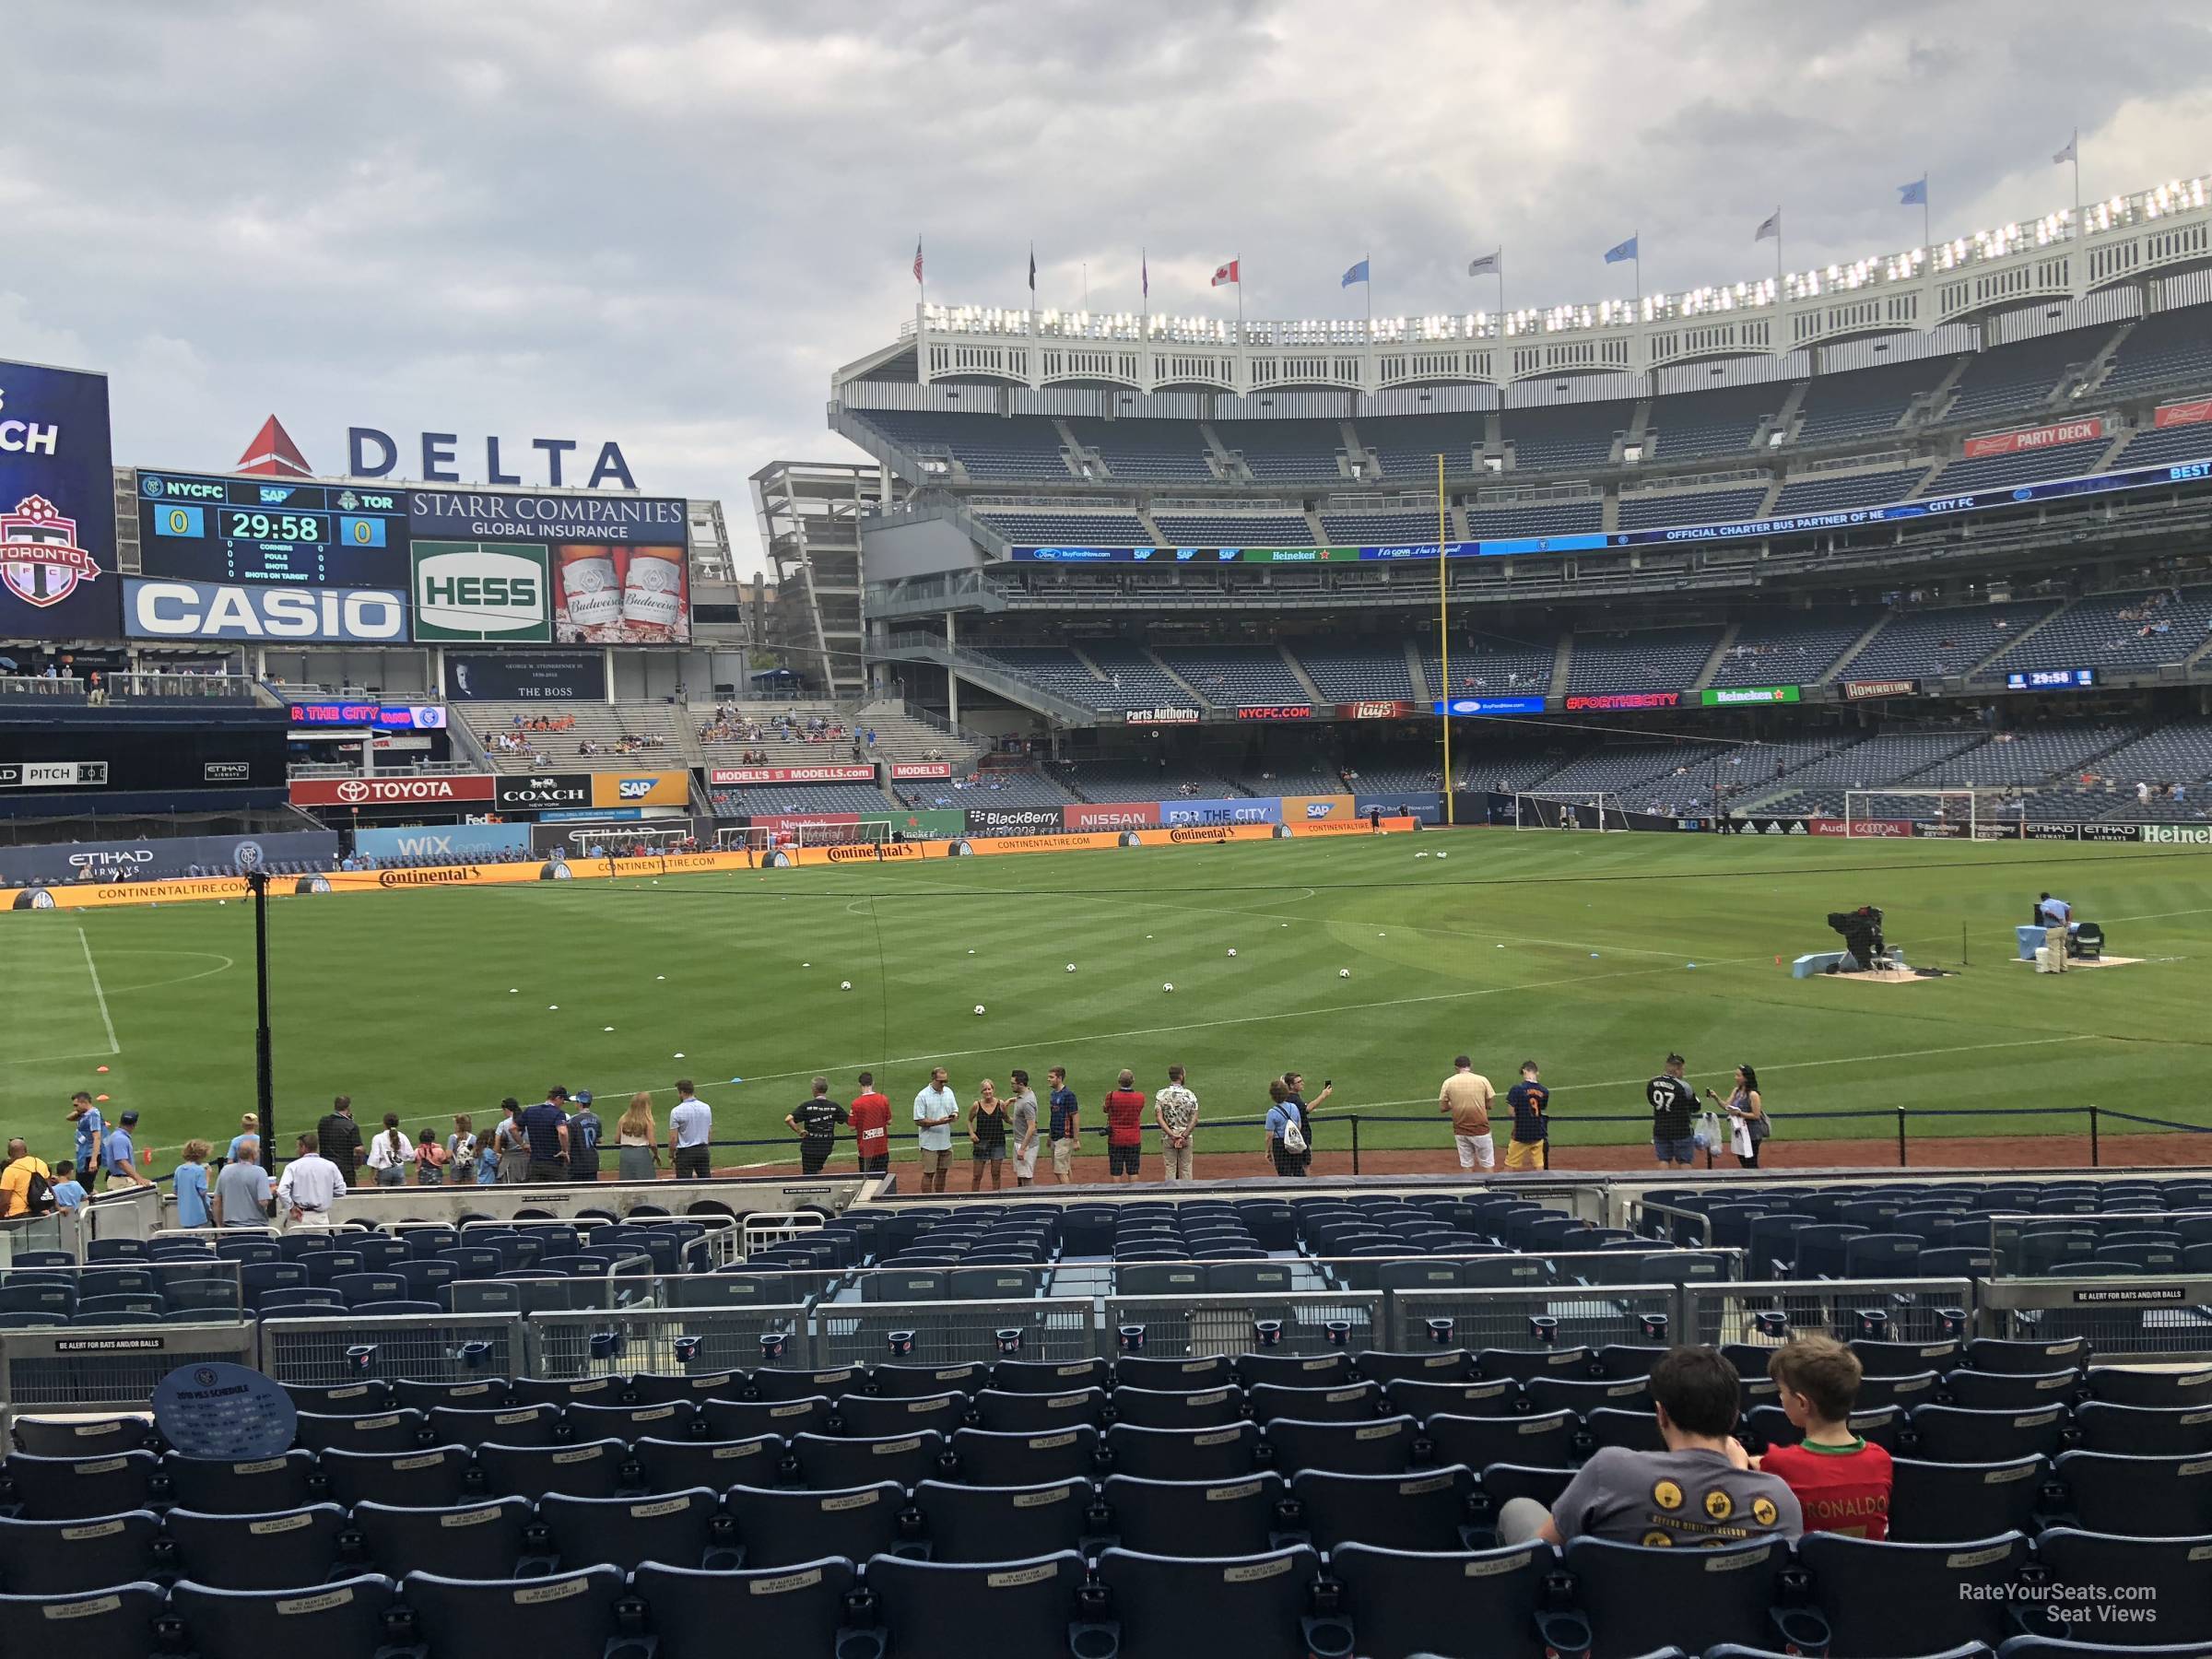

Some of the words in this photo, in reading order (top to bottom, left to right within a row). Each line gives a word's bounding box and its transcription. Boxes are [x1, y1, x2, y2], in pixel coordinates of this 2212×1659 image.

[2017, 429, 2055, 448] PARTY
[2058, 423, 2093, 441] DECK
[347, 427, 639, 490] DELTA
[2170, 463, 2212, 480] BEST
[167, 482, 224, 500] NYCFC
[260, 489, 288, 503] SAP
[360, 496, 393, 509] TOR
[413, 493, 510, 519] STARR
[515, 497, 683, 524] COMPANIES
[170, 509, 189, 534] 0
[1666, 527, 1717, 540] OFFICIAL
[1720, 523, 1771, 535] CHARTER
[1772, 520, 1795, 530] BUS
[1797, 514, 1848, 528] PARTNER
[1850, 512, 1868, 523] OF
[1869, 510, 1884, 521] NE
[1929, 500, 1956, 512] CITY
[1958, 497, 1974, 508] FC
[232, 513, 318, 541] 29:58
[353, 520, 371, 544] 0
[472, 522, 535, 536] GLOBAL
[538, 524, 629, 538] INSURANCE
[0, 547, 80, 564] TORONTO
[1134, 550, 1150, 559] SAP
[1176, 550, 1193, 559] SAP
[1218, 550, 1235, 559] SAP
[1273, 550, 1315, 560] Heineken
[426, 576, 536, 607] HESS
[136, 583, 402, 639] CASIO
[2032, 674, 2069, 684] 29:58
[518, 688, 541, 697] THE
[545, 688, 572, 697] BOSS
[1717, 690, 1772, 703] Heineken
[1850, 682, 1912, 698] ADMIRATION
[1567, 693, 1678, 710] #FORTHECITY
[307, 706, 339, 720] THE
[343, 706, 380, 720] CITY
[1126, 710, 1153, 720] Parts
[1154, 707, 1199, 720] Authority
[1239, 708, 1310, 719] NYCFC.COM
[29, 769, 70, 780] PITCH
[716, 771, 770, 782] MODELL'S
[791, 769, 868, 780] MODELLS.com
[897, 765, 945, 776] MODELL'S
[371, 782, 453, 798] TOYOTA
[503, 788, 585, 802] COACH
[619, 782, 652, 797] SAP
[1170, 810, 1199, 822] FOR
[1203, 809, 1230, 820] THE
[1235, 807, 1267, 820] CITY
[1307, 804, 1329, 817] SAP
[465, 813, 503, 825] FedEx
[987, 812, 1057, 826] BlackBerry
[1081, 813, 1146, 826] NISSAN
[1819, 823, 1846, 832] Audi
[2027, 825, 2074, 833] ETIHAD
[2084, 826, 2136, 834] ETIHAD
[1170, 828, 1227, 842] Continental
[997, 837, 1090, 850] CONTINENTALTIRE.COM
[69, 850, 153, 866] ETIHAD
[379, 867, 467, 888] Continental
[98, 882, 249, 900] CONTINENTALTIRE.COM
[1653, 1090, 1675, 1112] 97
[210, 1384, 250, 1398] SCHEDULE
[1807, 1495, 1887, 1518] RONALDO
